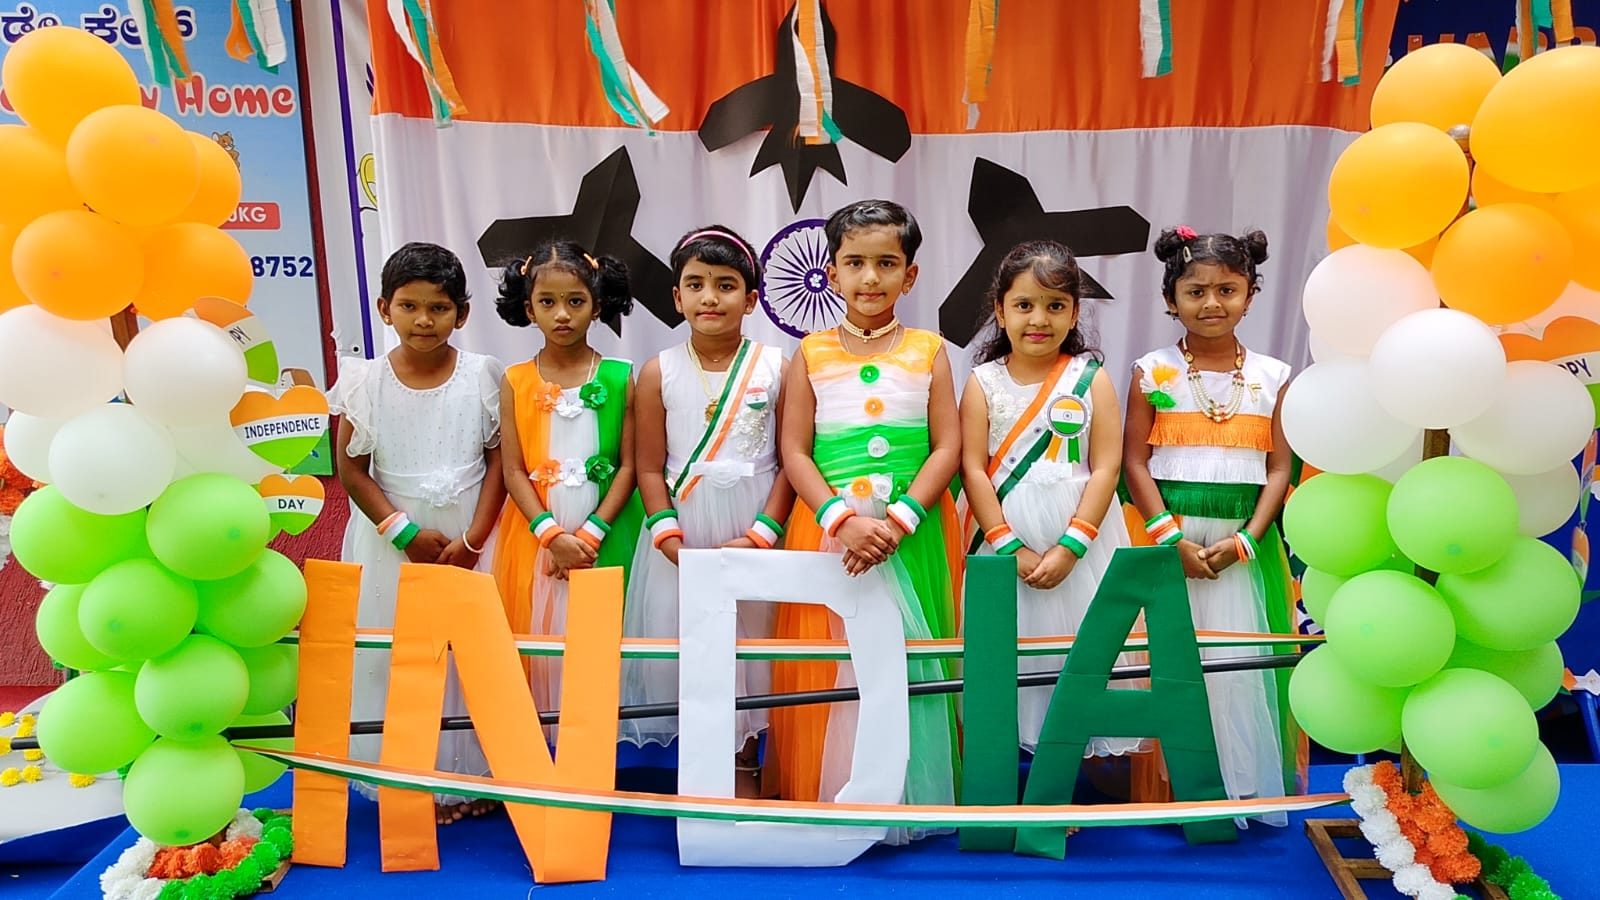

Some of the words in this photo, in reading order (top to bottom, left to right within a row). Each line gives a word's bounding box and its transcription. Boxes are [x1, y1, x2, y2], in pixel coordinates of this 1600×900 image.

[175, 75, 293, 115] Home
[250, 256, 314, 277] 8752
[1557, 357, 1592, 378] PY
[244, 417, 321, 439] INDEPENDENCE
[277, 498, 305, 510] DAY
[291, 546, 1238, 885] INDIA
